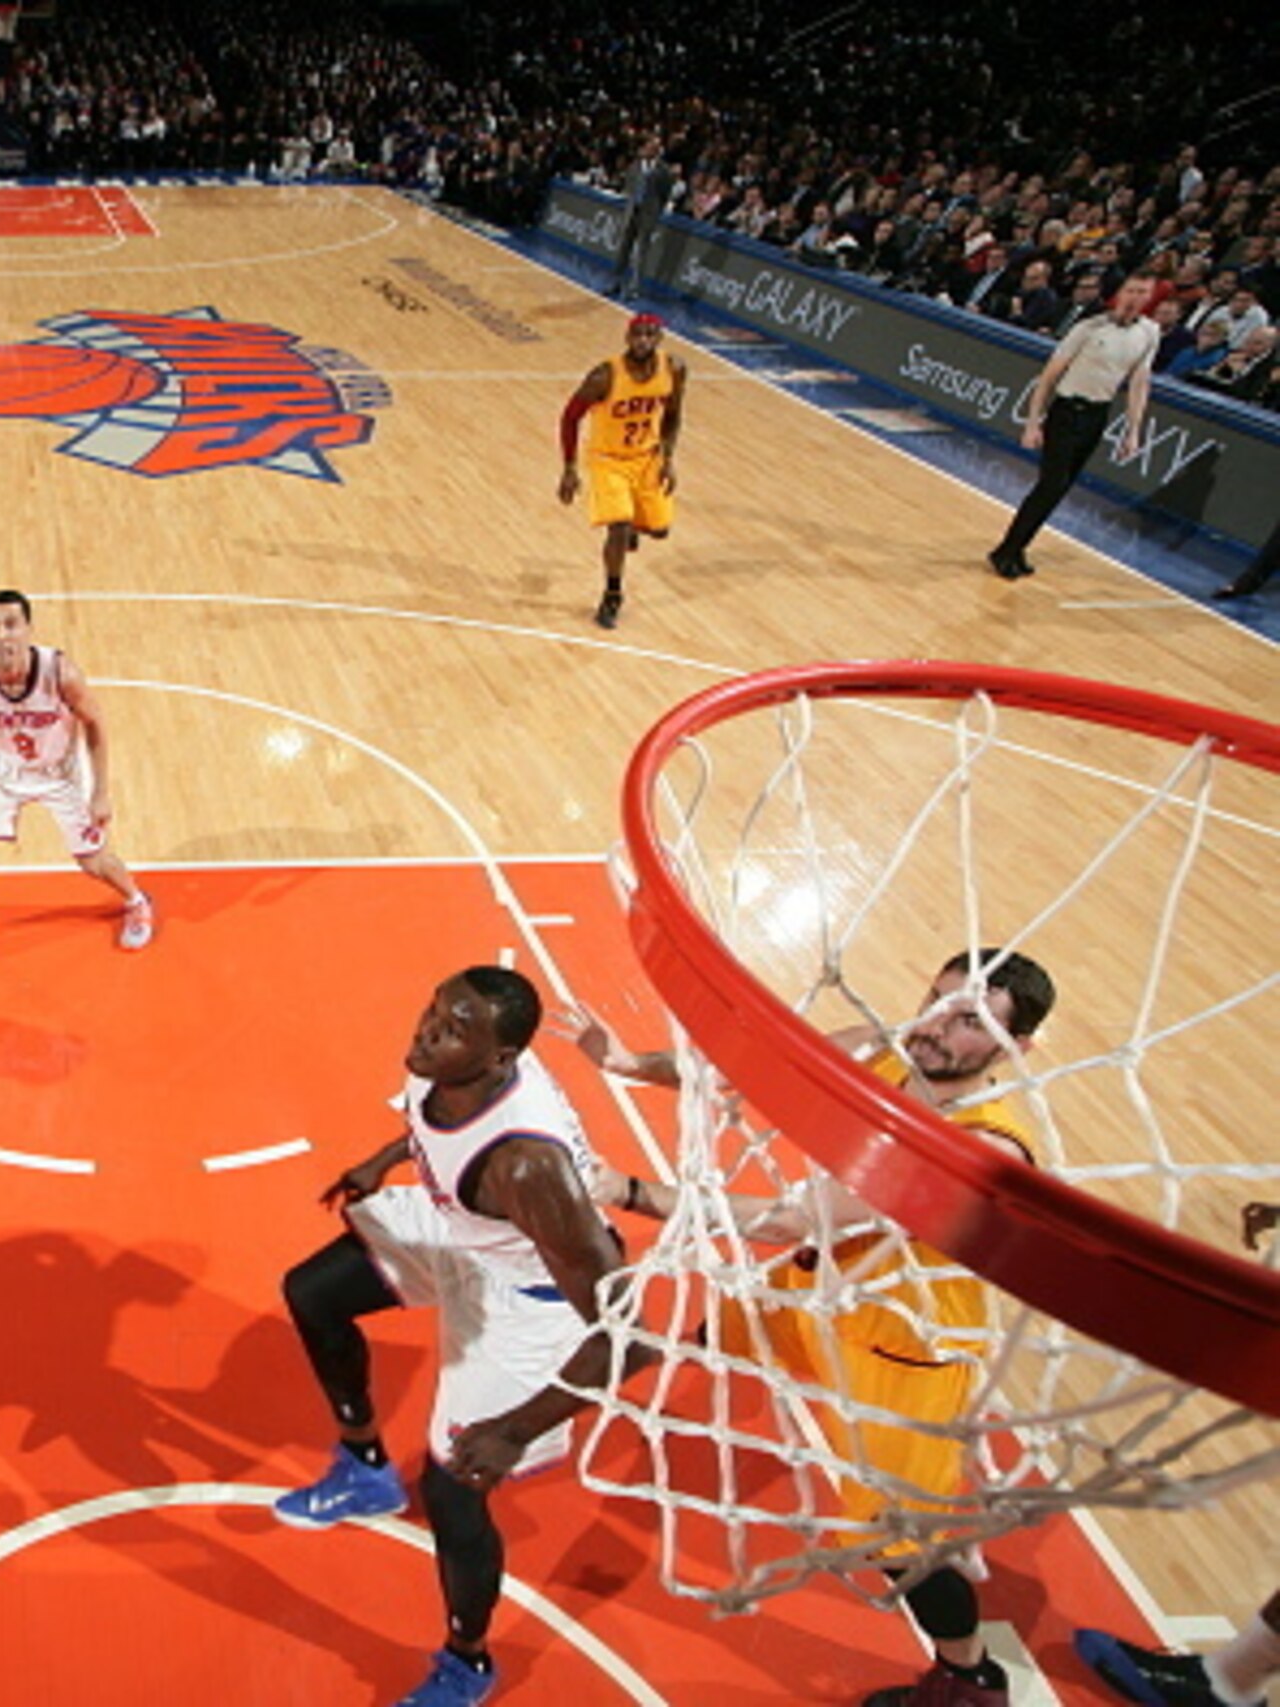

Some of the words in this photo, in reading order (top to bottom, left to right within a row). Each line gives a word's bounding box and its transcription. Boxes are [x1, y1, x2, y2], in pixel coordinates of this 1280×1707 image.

[681, 256, 746, 311] Samsung
[744, 270, 857, 342] GALAXY
[899, 344, 1008, 419] Samsung
[1012, 378, 1217, 484] GAXY
